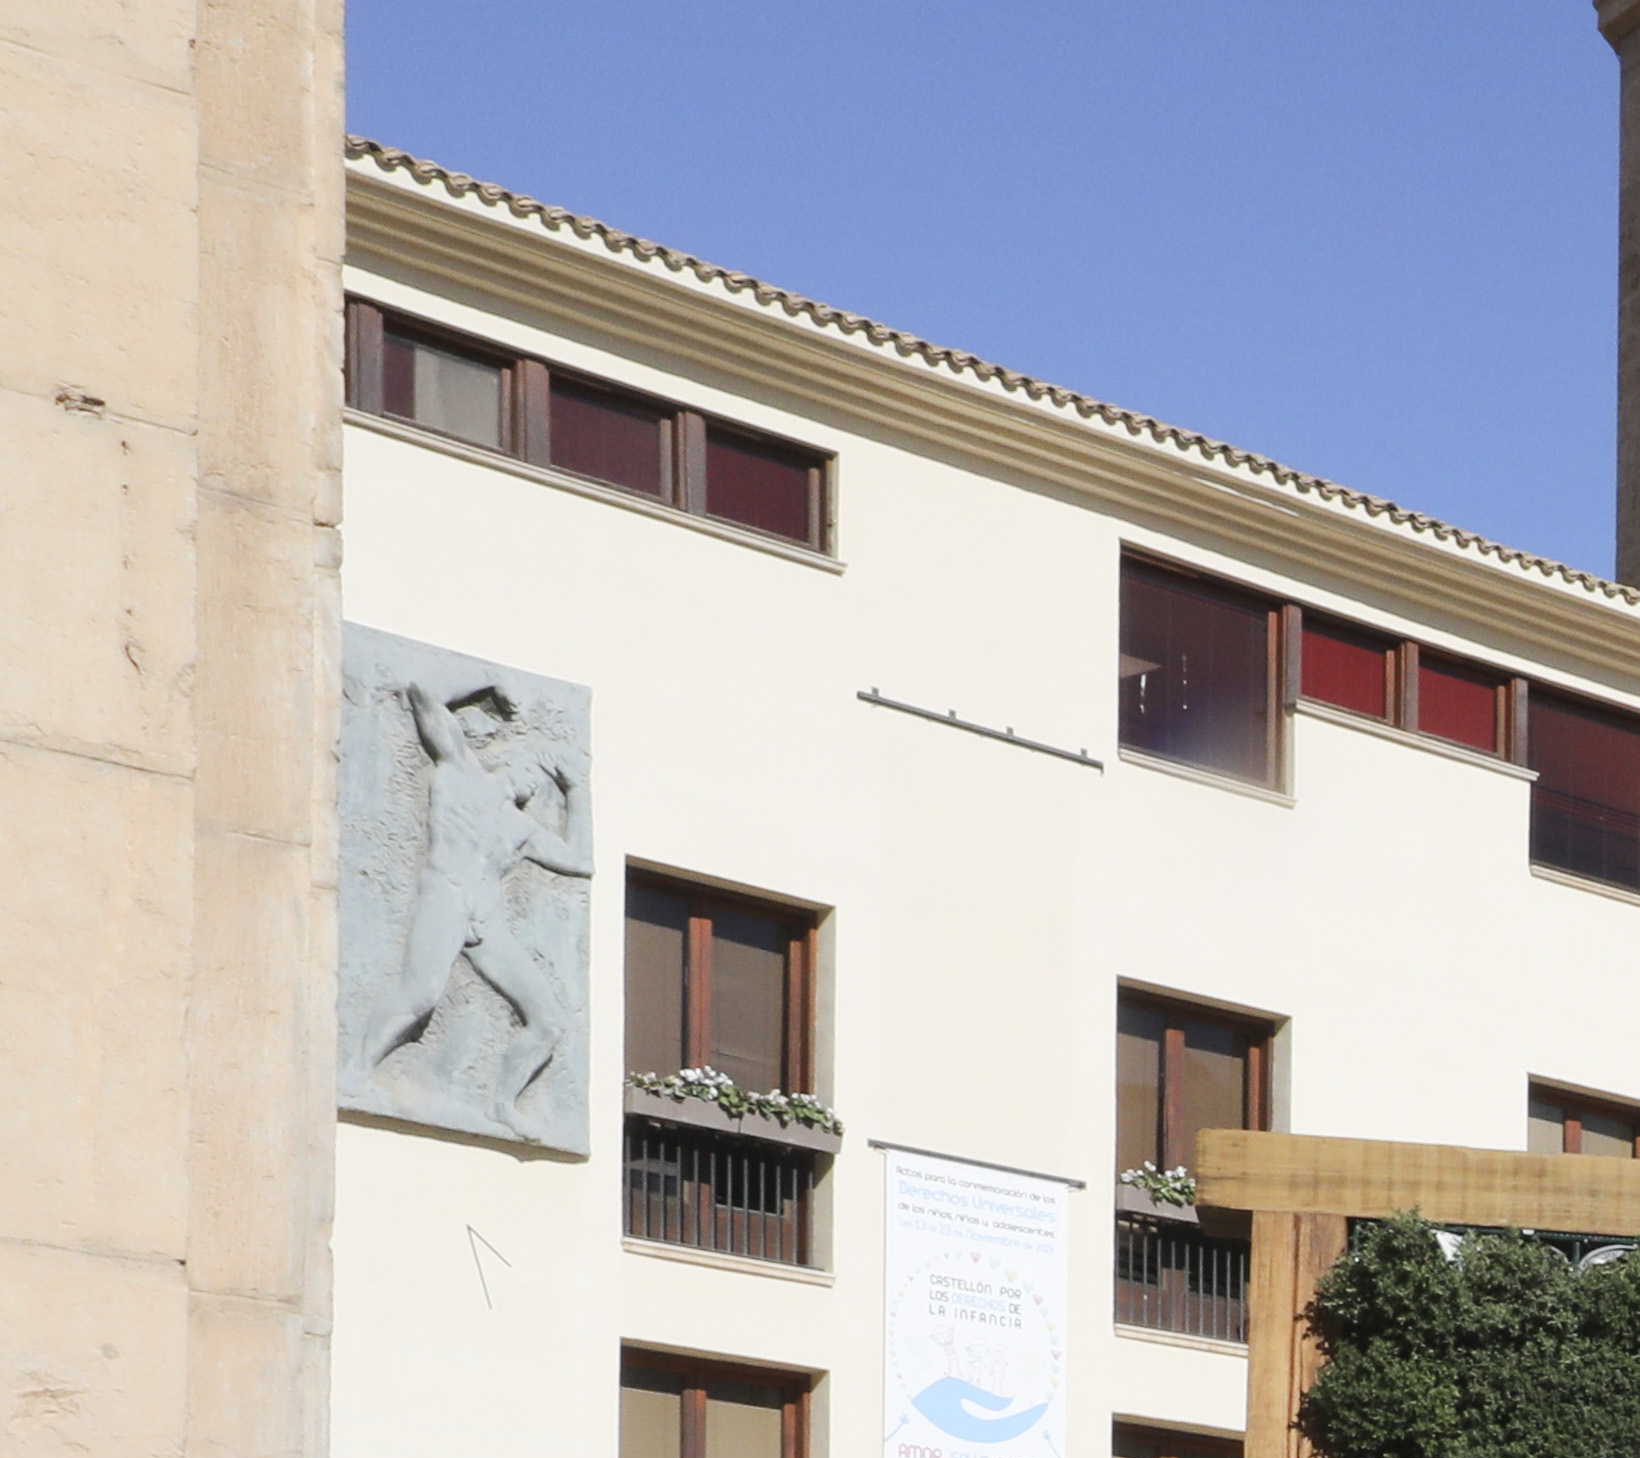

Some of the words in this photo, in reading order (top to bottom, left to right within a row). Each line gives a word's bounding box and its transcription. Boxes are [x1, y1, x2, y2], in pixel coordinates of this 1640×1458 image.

[896, 1165, 923, 1180] Actos
[925, 1172, 946, 1185] para
[947, 1176, 957, 1186] la
[958, 1179, 1028, 1200] conmemoración
[1029, 1192, 1042, 1203] de
[1042, 1194, 1056, 1205] los
[898, 1180, 969, 1208] Derechos
[972, 1195, 1056, 1224] Universales
[897, 1201, 911, 1212] de
[912, 1202, 926, 1215] los
[982, 1219, 990, 1228] y
[992, 1219, 1055, 1238] adolescentes
[966, 1228, 1021, 1248] Noviembre
[929, 1273, 992, 1296] CASTELLÓN
[1000, 1286, 1022, 1300] POR
[929, 1290, 950, 1303] LOS
[951, 1292, 1006, 1313] DERECHOS
[1008, 1303, 1022, 1316] DE
[929, 1303, 947, 1317] LA
[954, 1307, 1023, 1330] INFANCIA
